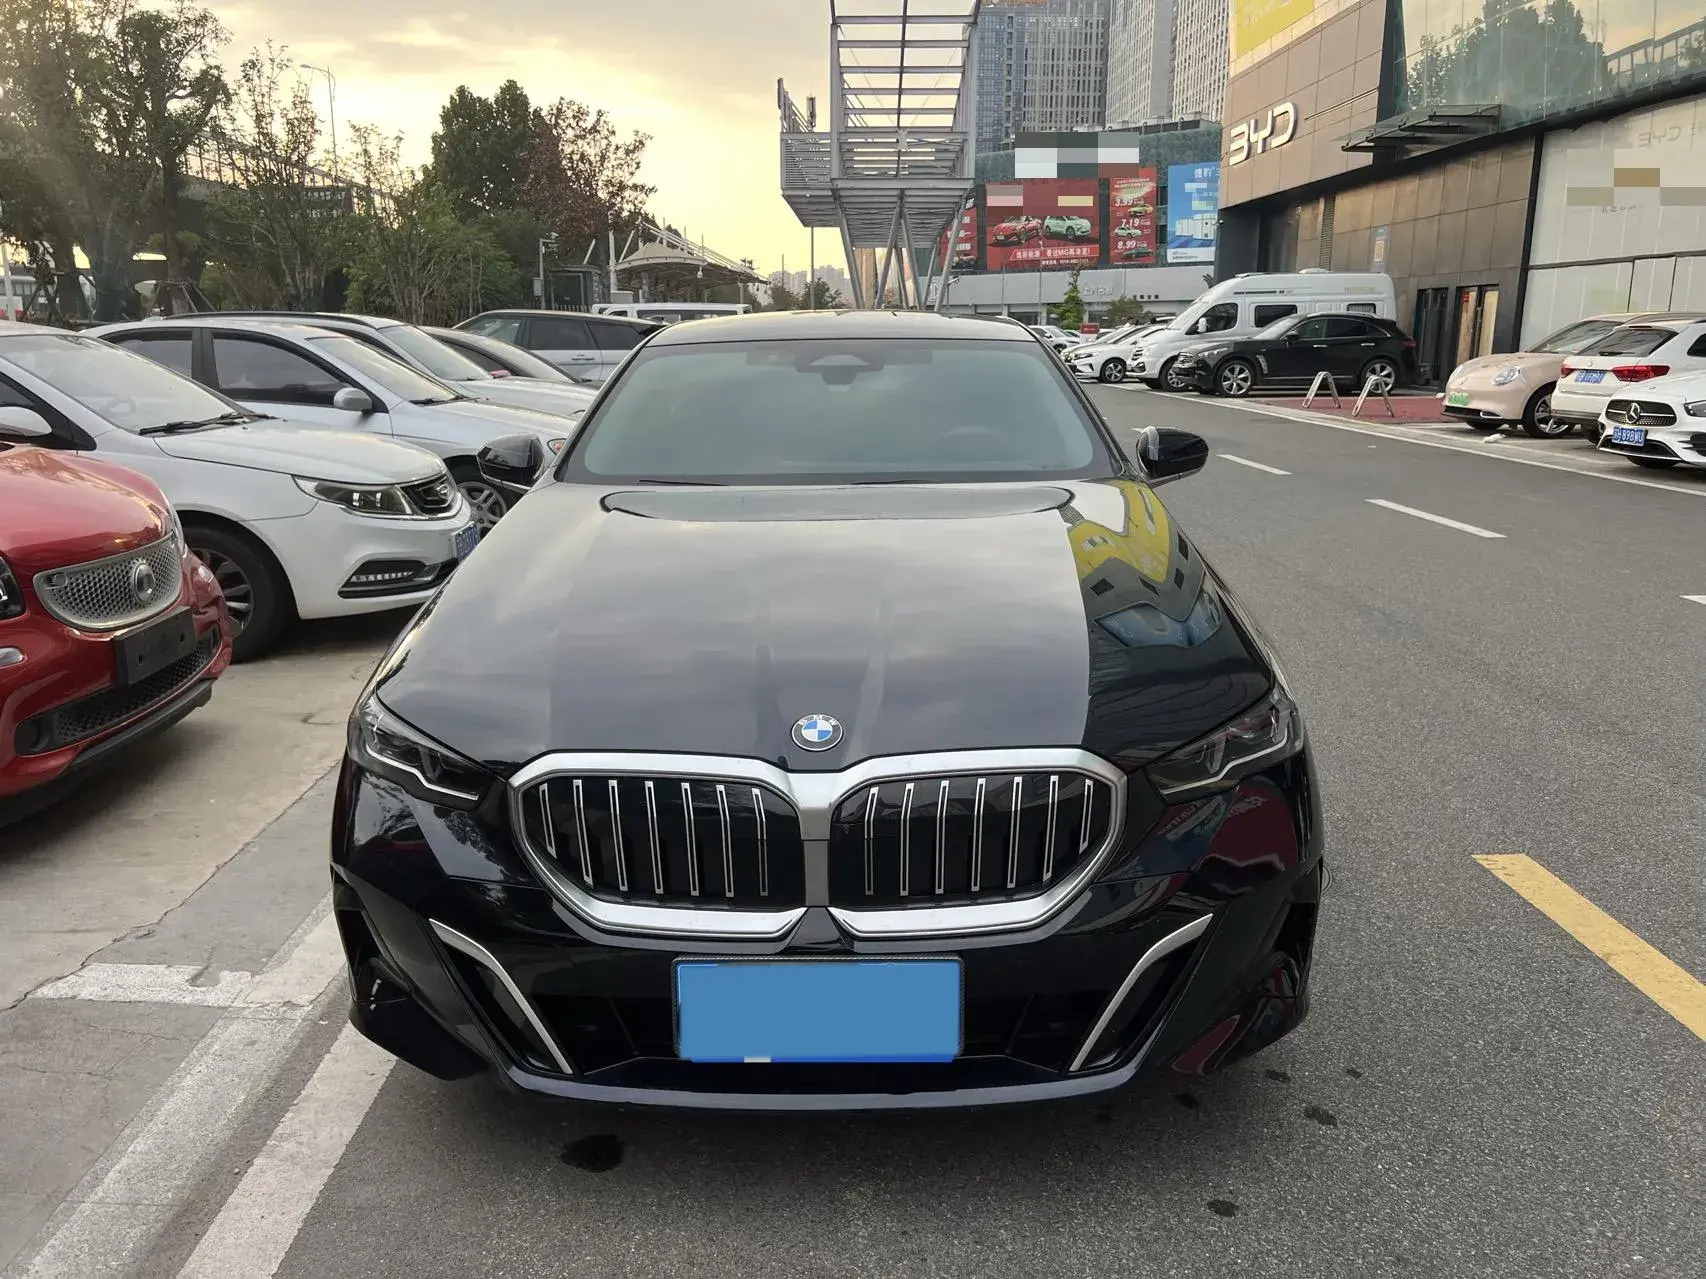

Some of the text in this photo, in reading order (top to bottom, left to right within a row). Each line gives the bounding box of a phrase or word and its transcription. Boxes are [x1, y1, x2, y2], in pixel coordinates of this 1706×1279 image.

[1229, 101, 1296, 166] BYD
[1115, 197, 1133, 207] 3.99
[1121, 218, 1140, 227] 7.19
[1117, 240, 1136, 249] 8.99
[798, 714, 838, 726] BMW
